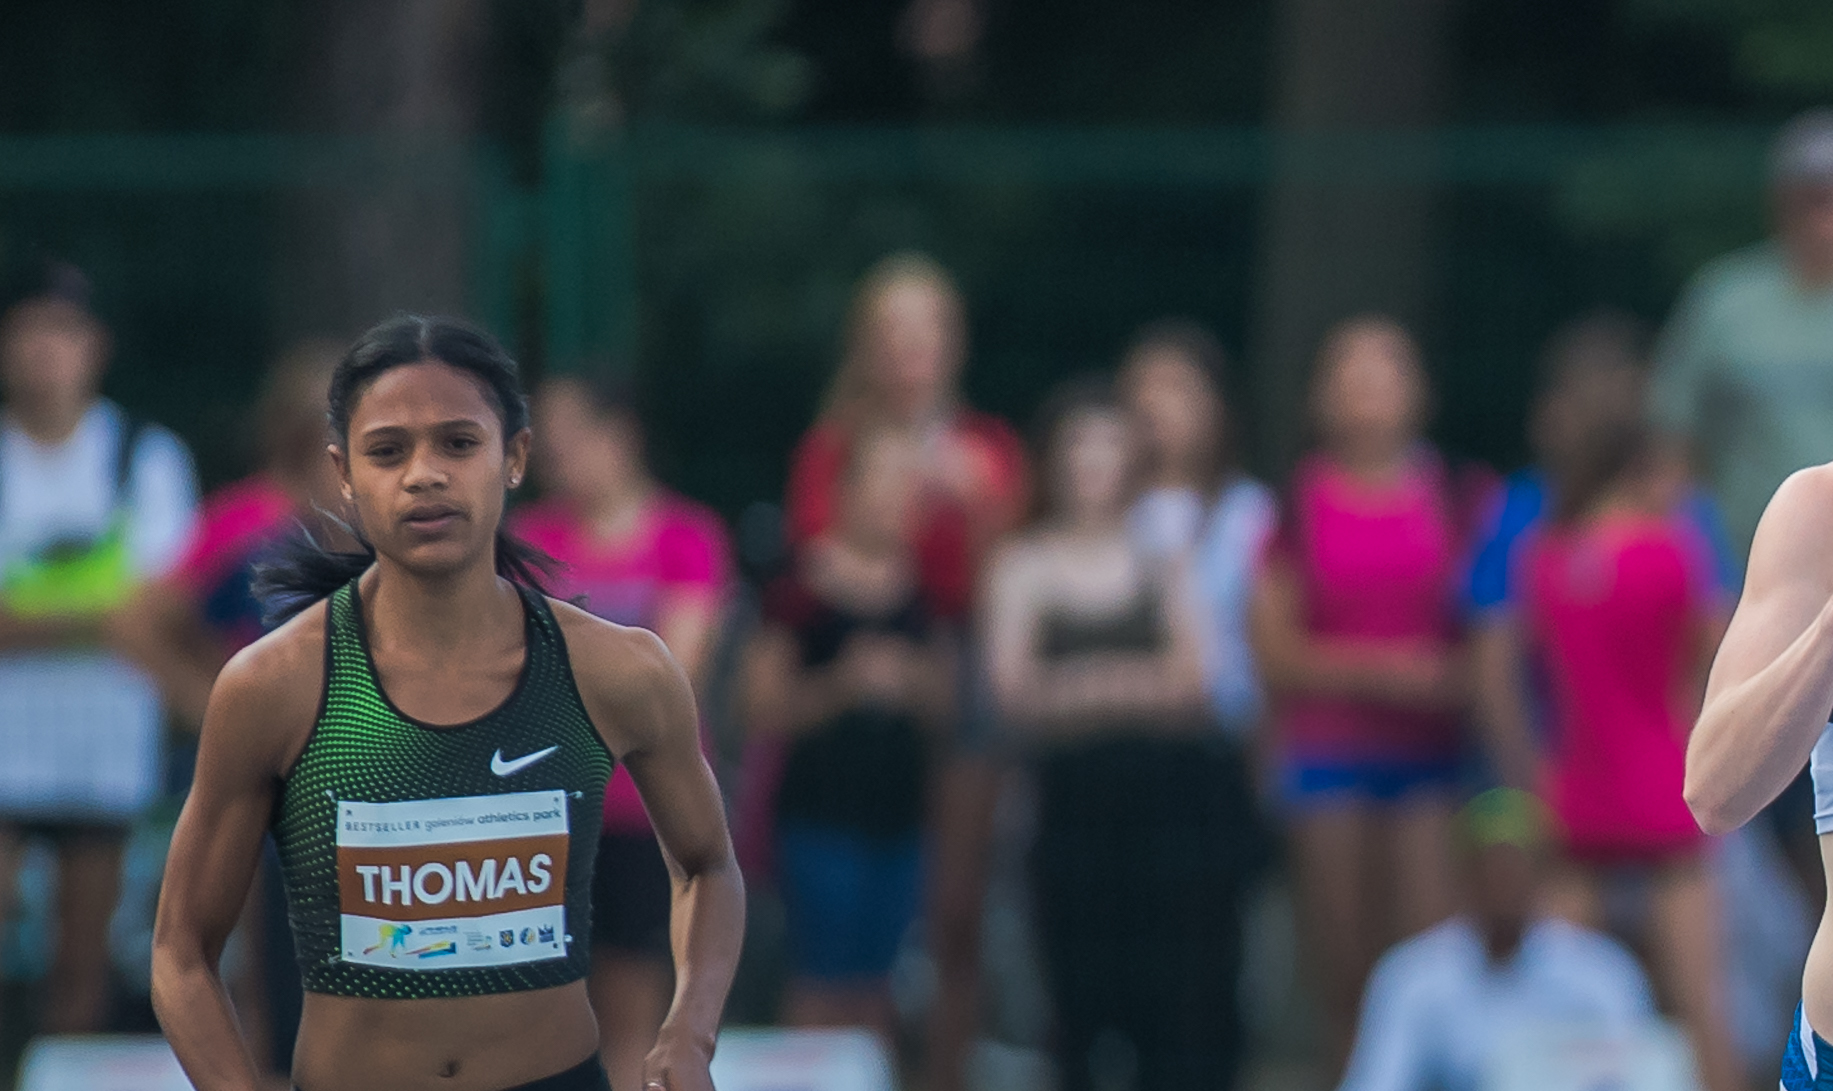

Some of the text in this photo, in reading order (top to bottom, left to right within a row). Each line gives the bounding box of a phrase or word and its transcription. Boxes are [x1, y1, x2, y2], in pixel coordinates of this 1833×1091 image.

[345, 820, 420, 832] BESTSELLER
[477, 811, 530, 824] athletics
[533, 807, 561, 822] park
[356, 853, 552, 906] THOMAS
